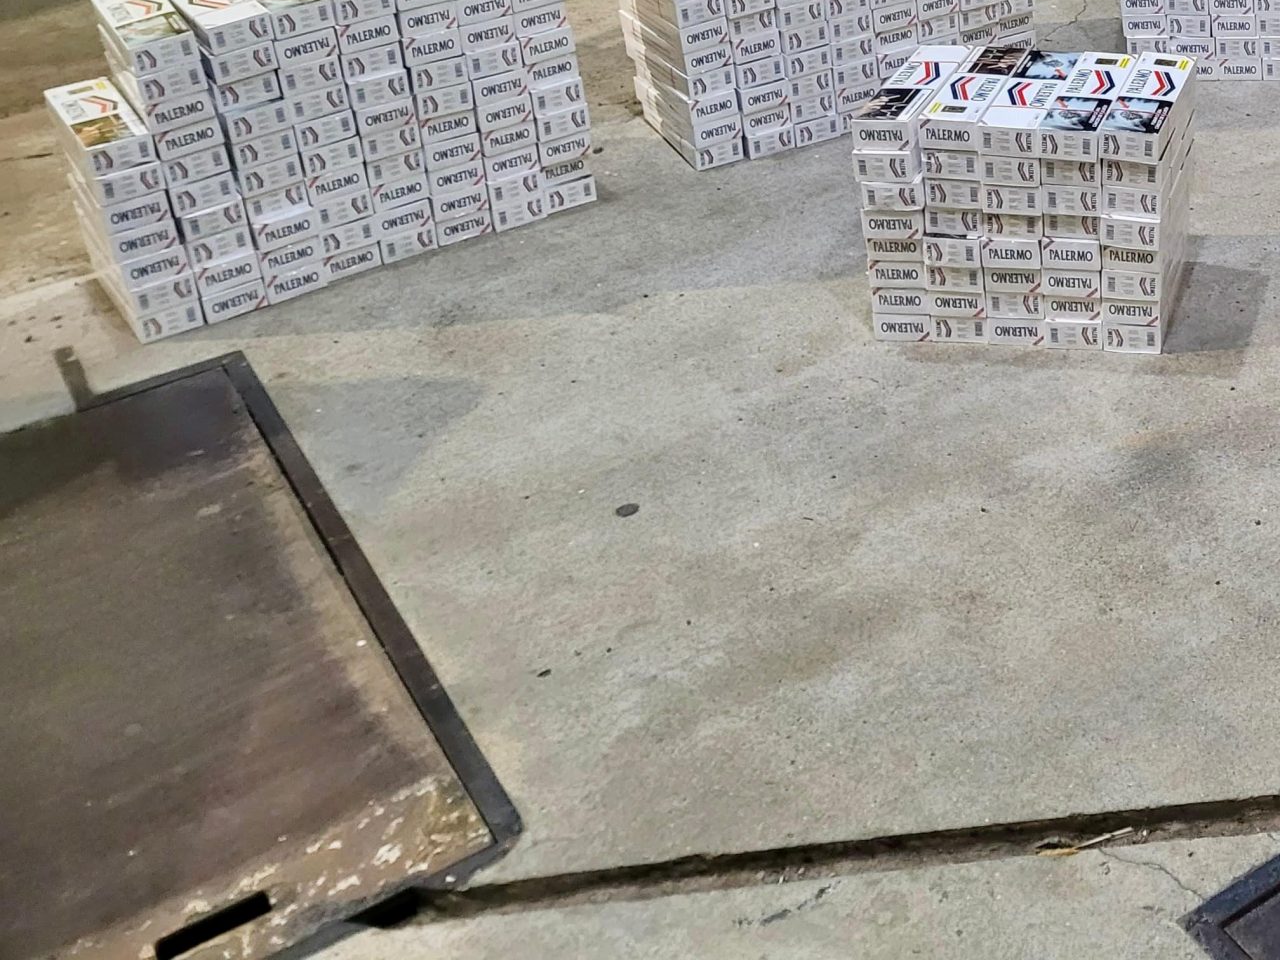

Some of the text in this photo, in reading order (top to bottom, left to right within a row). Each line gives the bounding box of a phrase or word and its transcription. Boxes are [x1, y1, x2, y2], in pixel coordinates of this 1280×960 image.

[1125, 0, 1159, 8] PALERMO
[521, 10, 561, 28] PALERMO
[880, 8, 912, 24] PALERMO
[346, 23, 391, 45] PALERMO
[467, 24, 509, 43] PALERMO
[1217, 22, 1250, 31] PALERMO
[880, 29, 912, 46] PALERMO
[529, 36, 568, 58] PALERMO
[740, 39, 775, 56] PALERMO
[481, 78, 522, 97] PALERMO
[970, 77, 1000, 102] PALERMO
[1065, 68, 1093, 94] PALERMO
[1125, 68, 1153, 94] PALERMO
[842, 88, 875, 105] PALERMO
[486, 103, 526, 123] PALERMO
[696, 99, 732, 118] PALERMO
[427, 116, 469, 136] PALERMO
[701, 122, 736, 140] PALERMO
[859, 129, 903, 141] PALERMO
[926, 128, 970, 142] PALERMO
[490, 127, 530, 148] PALERMO
[546, 138, 585, 157] PALERMO
[315, 173, 359, 195] PALERMO
[379, 182, 422, 203] PALERMO
[440, 193, 481, 213] PALERMO
[382, 209, 425, 230] PALERMO
[869, 219, 912, 230] PALERMO
[264, 219, 310, 242] PALERMO
[873, 241, 917, 253] PALERMO
[989, 248, 1032, 260] PALERMO
[1049, 249, 1093, 262] PALERMO
[268, 246, 313, 269] PALERMO
[330, 251, 373, 273] PALERMO
[1109, 250, 1154, 264] PALERMO
[205, 263, 252, 286] PALERMO
[875, 269, 918, 280] PALERMO
[991, 272, 1034, 284] PALERMO
[1048, 276, 1092, 289] PALERMO
[212, 289, 259, 313] PALERMO
[878, 295, 921, 306] PALERMO
[935, 297, 978, 309] PALERMO
[1051, 300, 1094, 312] PALERMO
[1109, 304, 1152, 317] PALERMO
[881, 322, 924, 333] PALERMO
[995, 326, 1038, 337] PALERMO
